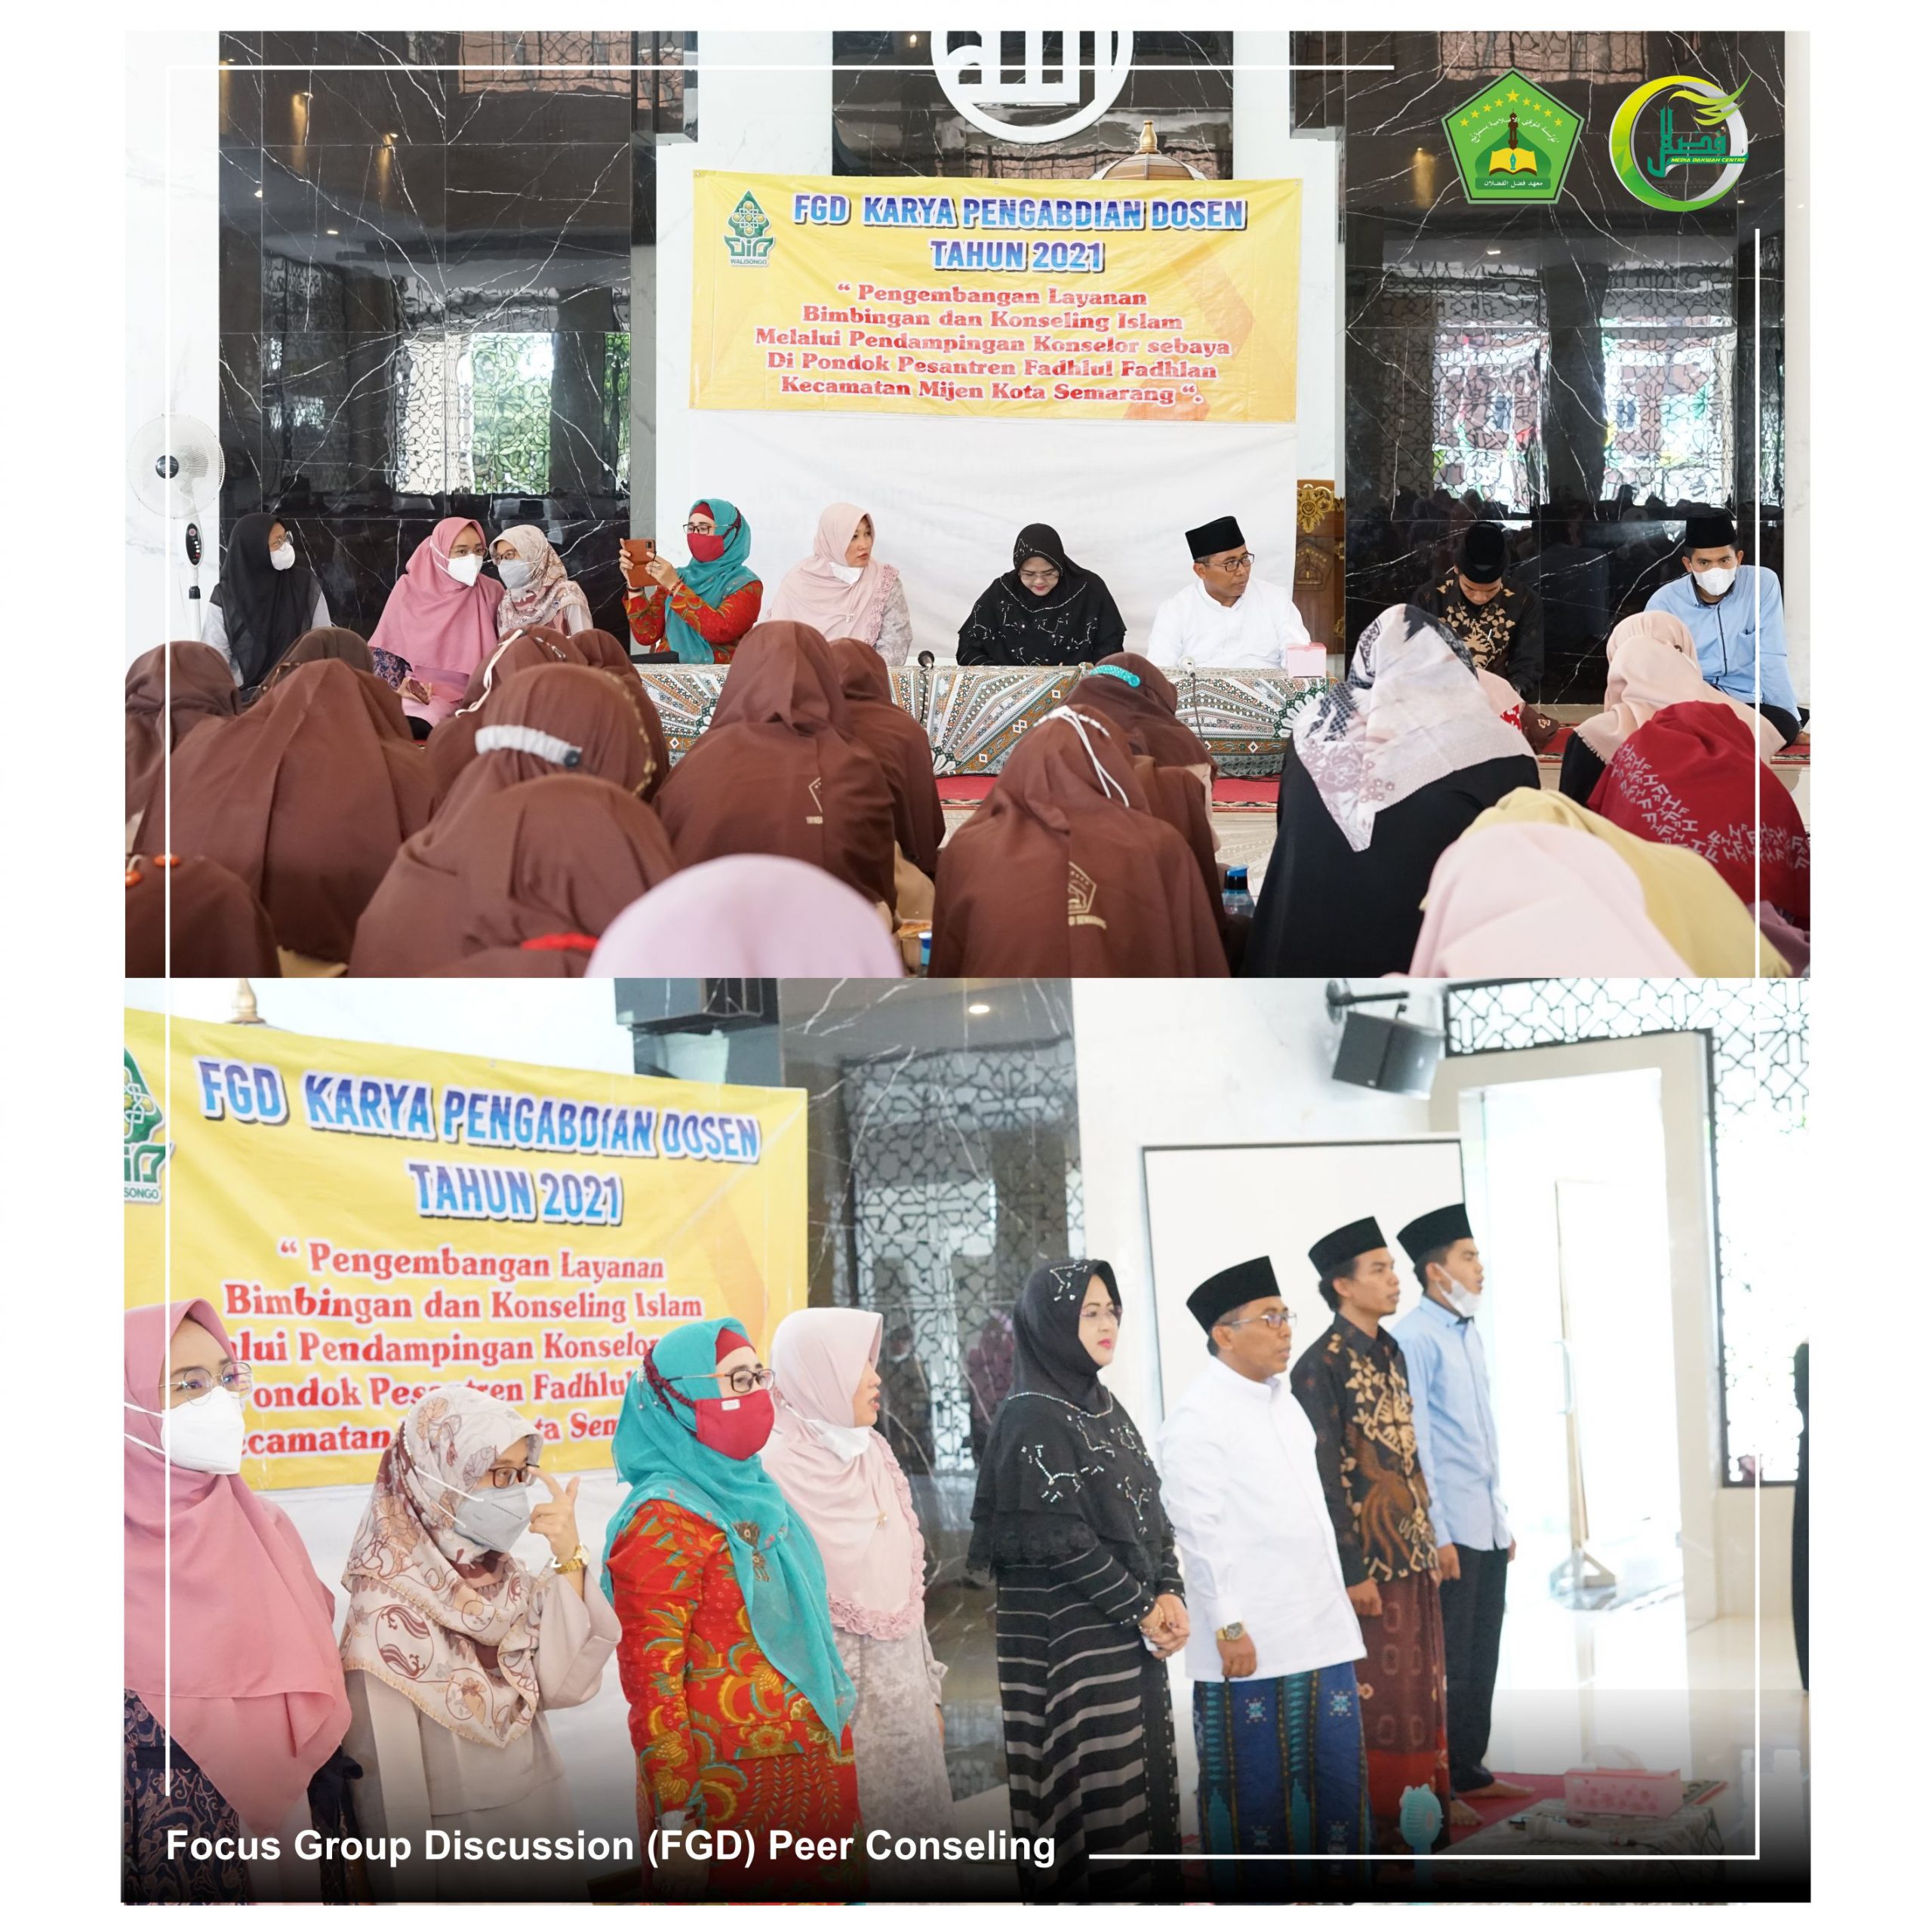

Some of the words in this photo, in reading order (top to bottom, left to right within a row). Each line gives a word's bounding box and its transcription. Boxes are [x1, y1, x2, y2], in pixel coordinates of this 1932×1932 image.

[794, 194, 848, 223] FGD
[863, 195, 955, 226] KARYA
[962, 198, 1142, 228] PENGABDIAN
[1152, 200, 1244, 228] DOSEN
[931, 239, 1024, 269] TAHUN
[1032, 241, 1101, 269] 2021
[858, 284, 1040, 306] Pengembangan
[1048, 288, 1147, 308] Layanan
[802, 306, 931, 328] Bimbingan
[939, 309, 983, 326] dan
[991, 311, 1110, 332] Konseling
[1118, 312, 1183, 330] Islam
[755, 328, 841, 346] Melalui
[849, 330, 1025, 355] Pendampingan
[1033, 335, 1140, 354] Konselor
[1147, 337, 1231, 358] sebaya
[768, 352, 795, 368] Di
[801, 352, 890, 371] Pondok
[898, 355, 1016, 375] Pesantren
[1023, 359, 1113, 377] Fadhlul
[1121, 360, 1217, 378] Fadhlan
[781, 376, 911, 395] Kecamatan
[918, 380, 984, 401] Mijen
[992, 382, 1046, 399] Kota
[1054, 383, 1174, 405] Semarang
[198, 1060, 282, 1118] FGD
[305, 1074, 432, 1134] KARYA
[443, 1089, 654, 1153] PENGABDIAN
[661, 1112, 757, 1158] DOSEN
[124, 1188, 159, 1199] SONGO
[408, 1163, 534, 1215] TAHUN
[540, 1172, 620, 1220] 2021
[309, 1242, 550, 1282] Pengembangan
[561, 1251, 664, 1284] Layanan
[225, 1284, 413, 1324] Bimbingan
[424, 1290, 481, 1318] dan
[491, 1291, 626, 1323] Konseling
[635, 1292, 703, 1318] Islam
[299, 1331, 534, 1368] Pendampingan
[253, 1377, 361, 1407] ondok
